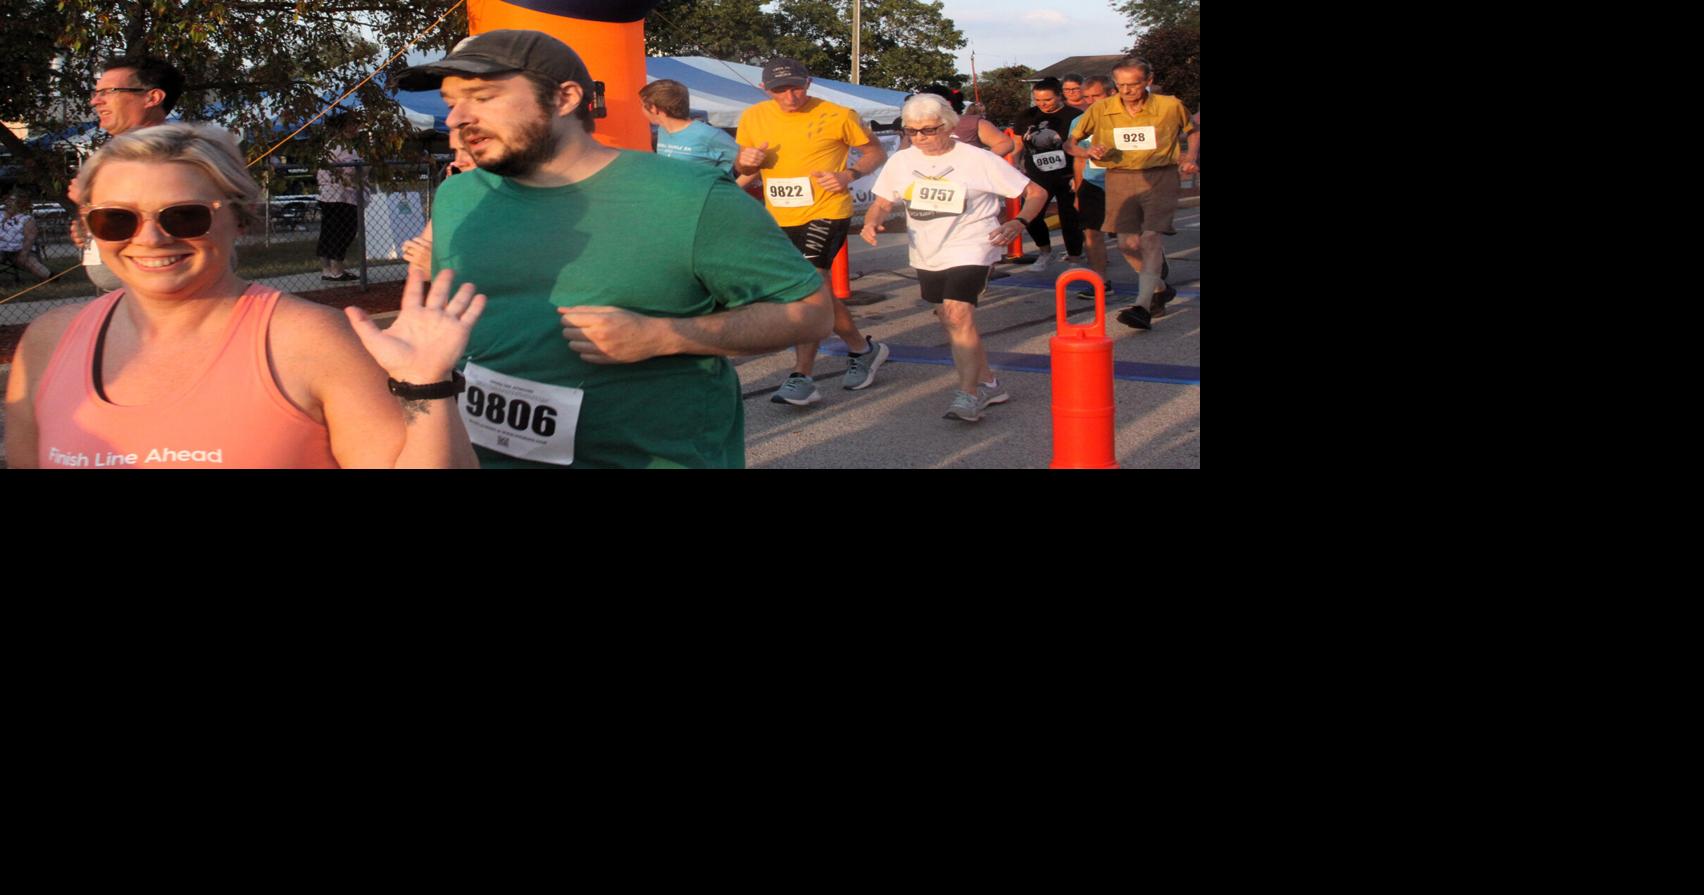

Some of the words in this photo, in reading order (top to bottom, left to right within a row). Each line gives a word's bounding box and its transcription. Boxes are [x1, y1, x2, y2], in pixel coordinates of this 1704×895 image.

[1123, 132, 1146, 143] 928
[1036, 155, 1062, 167] 9804
[770, 185, 804, 198] 9822
[919, 187, 955, 202] 9757
[805, 219, 832, 252] NIK
[466, 386, 558, 437] 9806
[48, 447, 89, 467] Finish
[95, 452, 138, 467] Line
[144, 447, 223, 463] Ahead
